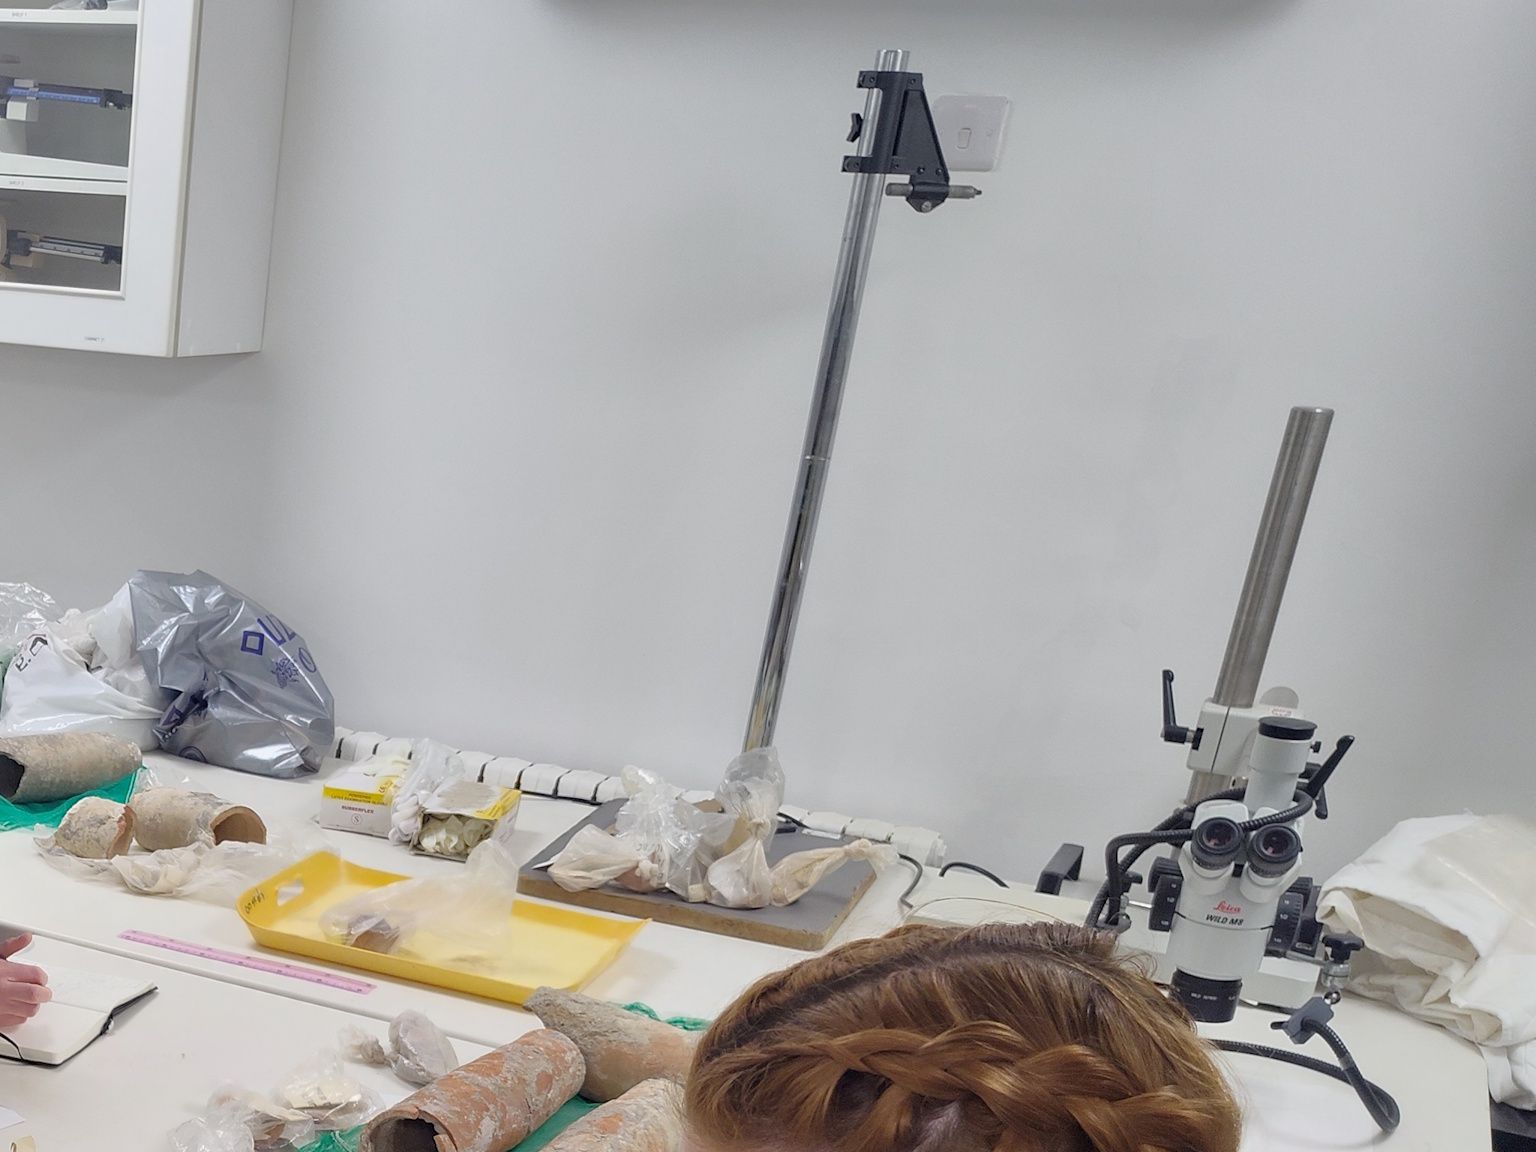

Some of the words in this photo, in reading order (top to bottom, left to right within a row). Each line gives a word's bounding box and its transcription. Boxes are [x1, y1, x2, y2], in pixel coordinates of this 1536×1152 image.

[1213, 900, 1242, 914] Leica
[1206, 914, 1228, 924] WILD
[1228, 917, 1244, 926] M8
